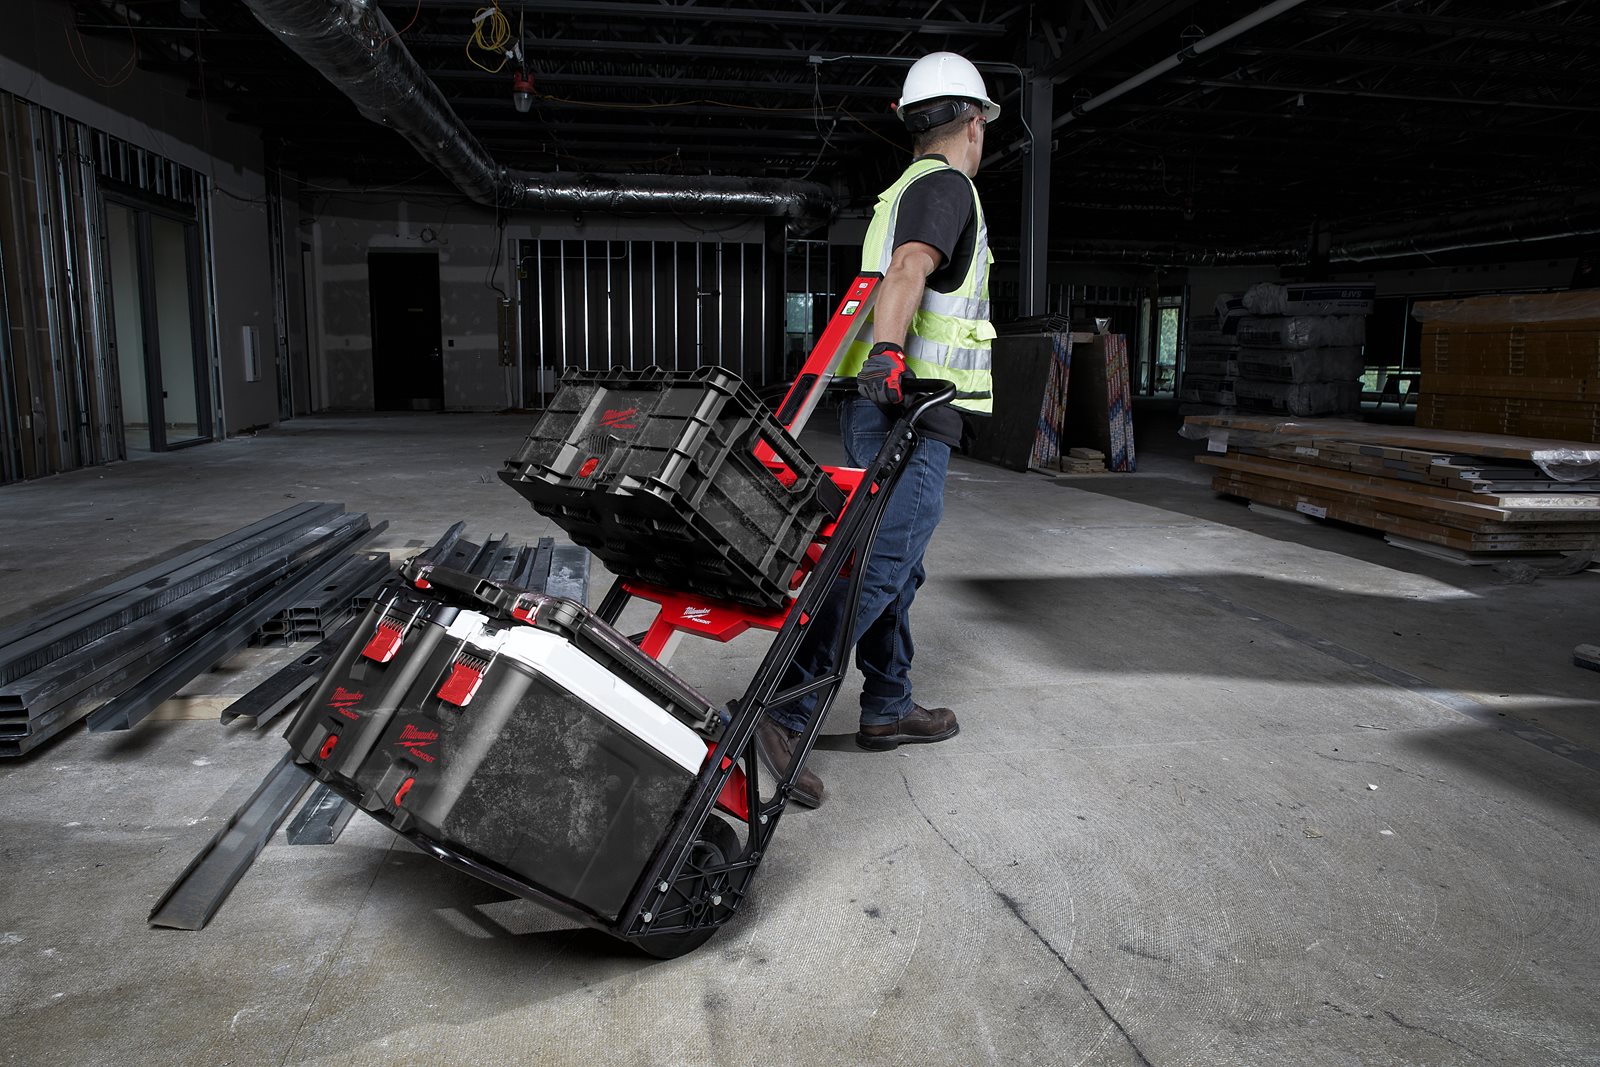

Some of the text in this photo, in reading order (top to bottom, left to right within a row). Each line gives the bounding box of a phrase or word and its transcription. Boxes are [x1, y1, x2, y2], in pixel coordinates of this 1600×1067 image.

[331, 687, 363, 701] Milwaukee
[400, 723, 439, 740] Milwaukee
[410, 747, 437, 762] PACKOUT
